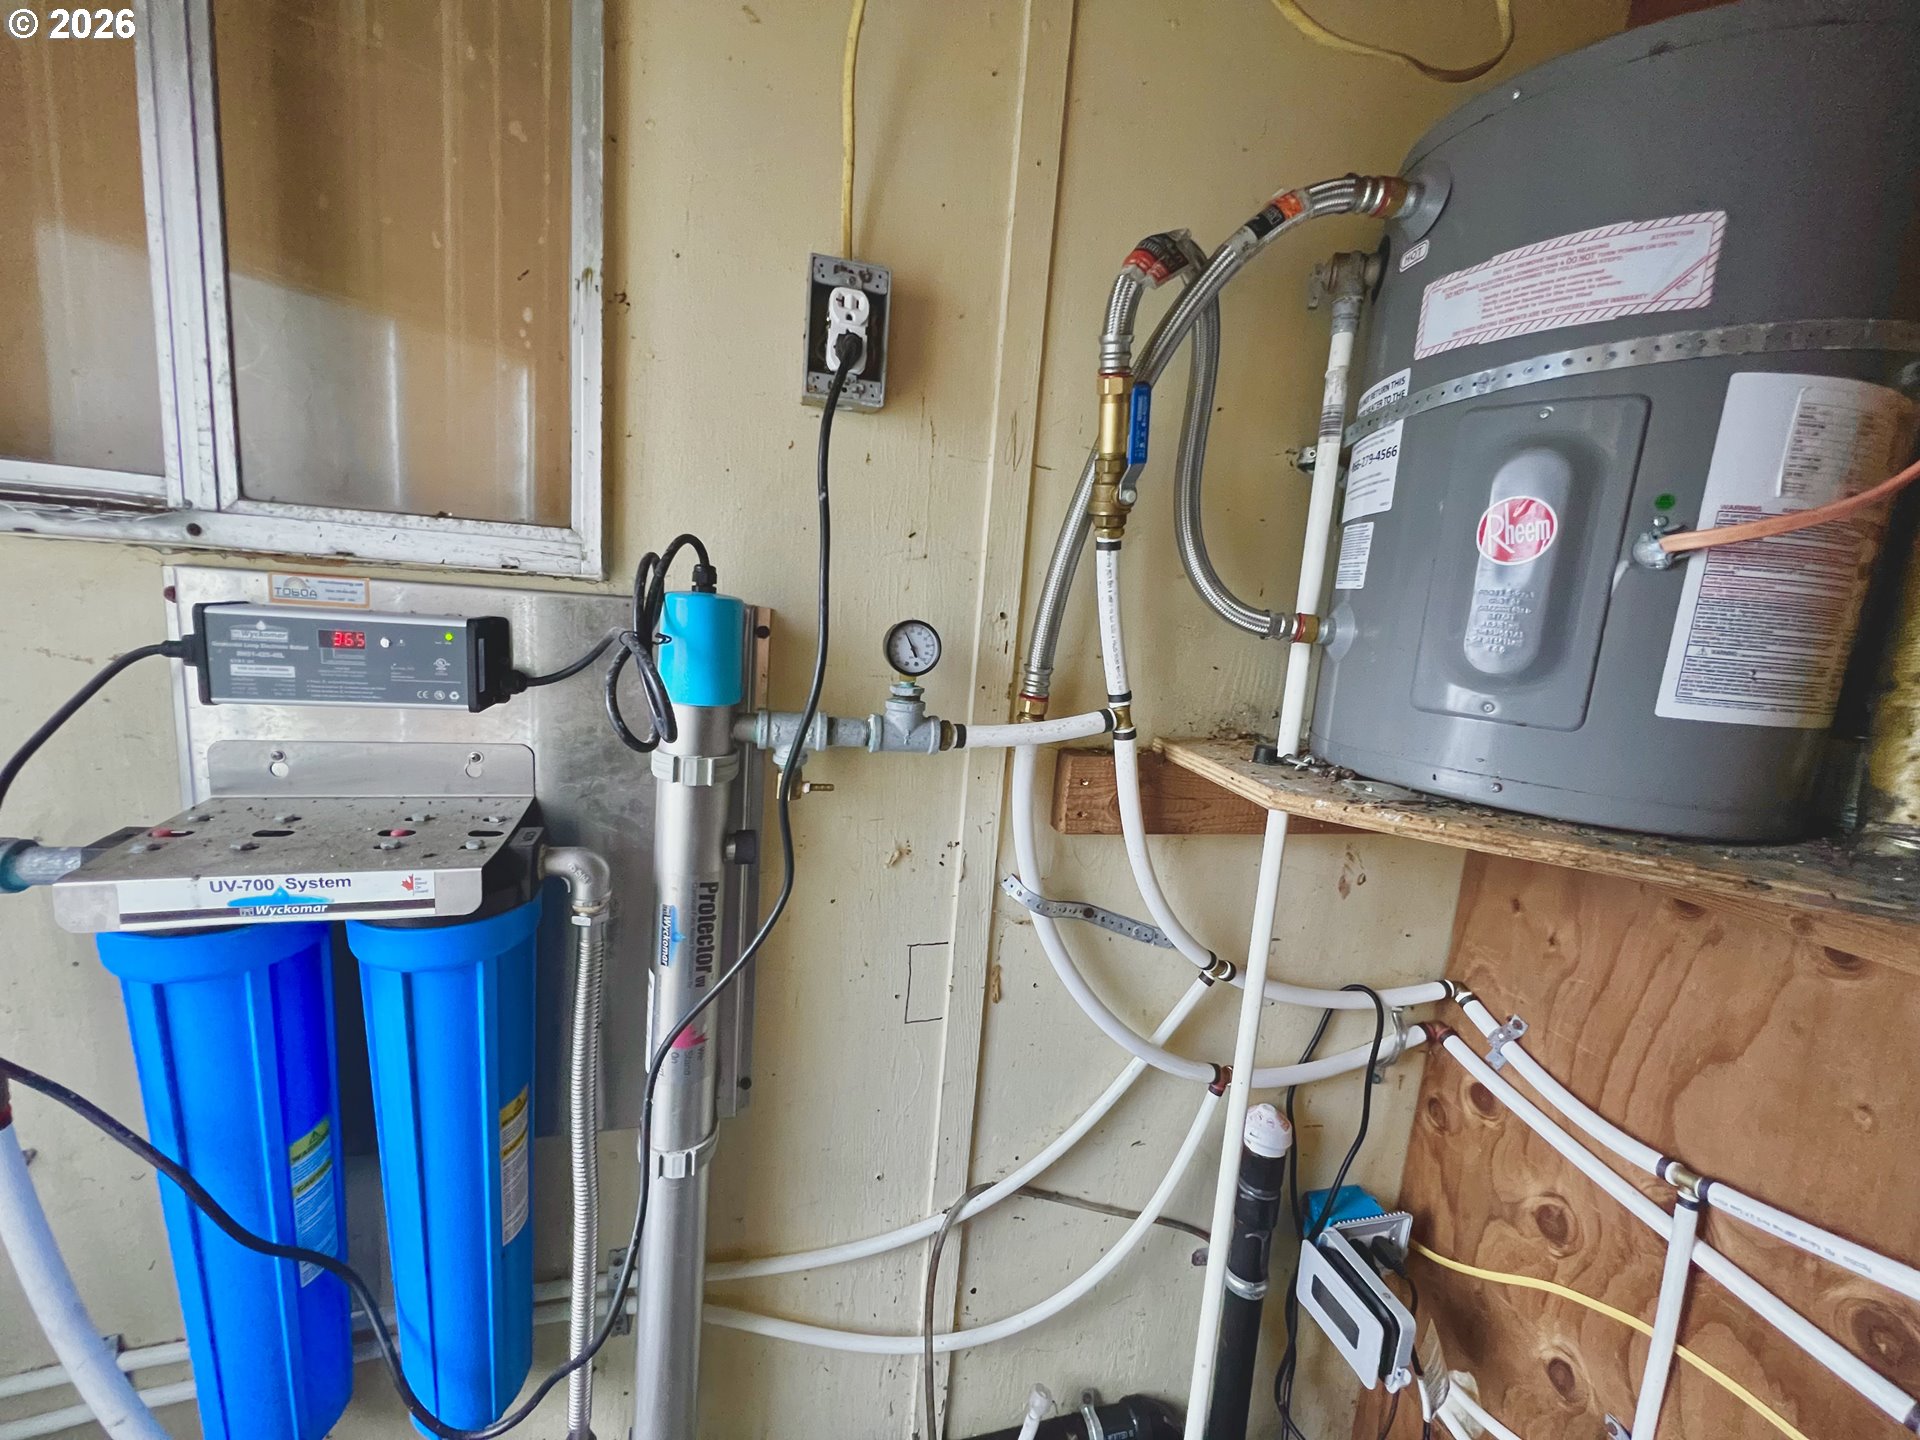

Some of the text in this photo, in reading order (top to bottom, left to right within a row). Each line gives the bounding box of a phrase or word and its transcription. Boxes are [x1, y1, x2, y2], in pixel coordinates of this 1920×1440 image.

[1651, 230, 1694, 239] ATTENTION
[1404, 246, 1425, 265] HOT
[1516, 258, 1543, 268] REMOVE
[1565, 256, 1577, 264] DO
[1579, 252, 1595, 262] NOT
[1677, 275, 1698, 291] PULL
[1476, 320, 1497, 330] HEATING
[1498, 313, 1527, 324] ELEMENTS
[1555, 302, 1584, 311] COVERED
[1610, 293, 1648, 302] WARRANTY
[1370, 384, 1390, 401] RETURN
[1390, 376, 1407, 390] THIS
[1384, 396, 1392, 405] TO
[1392, 389, 1407, 402] THE
[1487, 502, 1550, 555] Rheem
[332, 631, 365, 647] 365
[209, 876, 352, 893] UV-700 System
[254, 904, 328, 916] Wyckomar
[695, 882, 719, 974] Protector
[660, 914, 672, 967] Wyckomar
